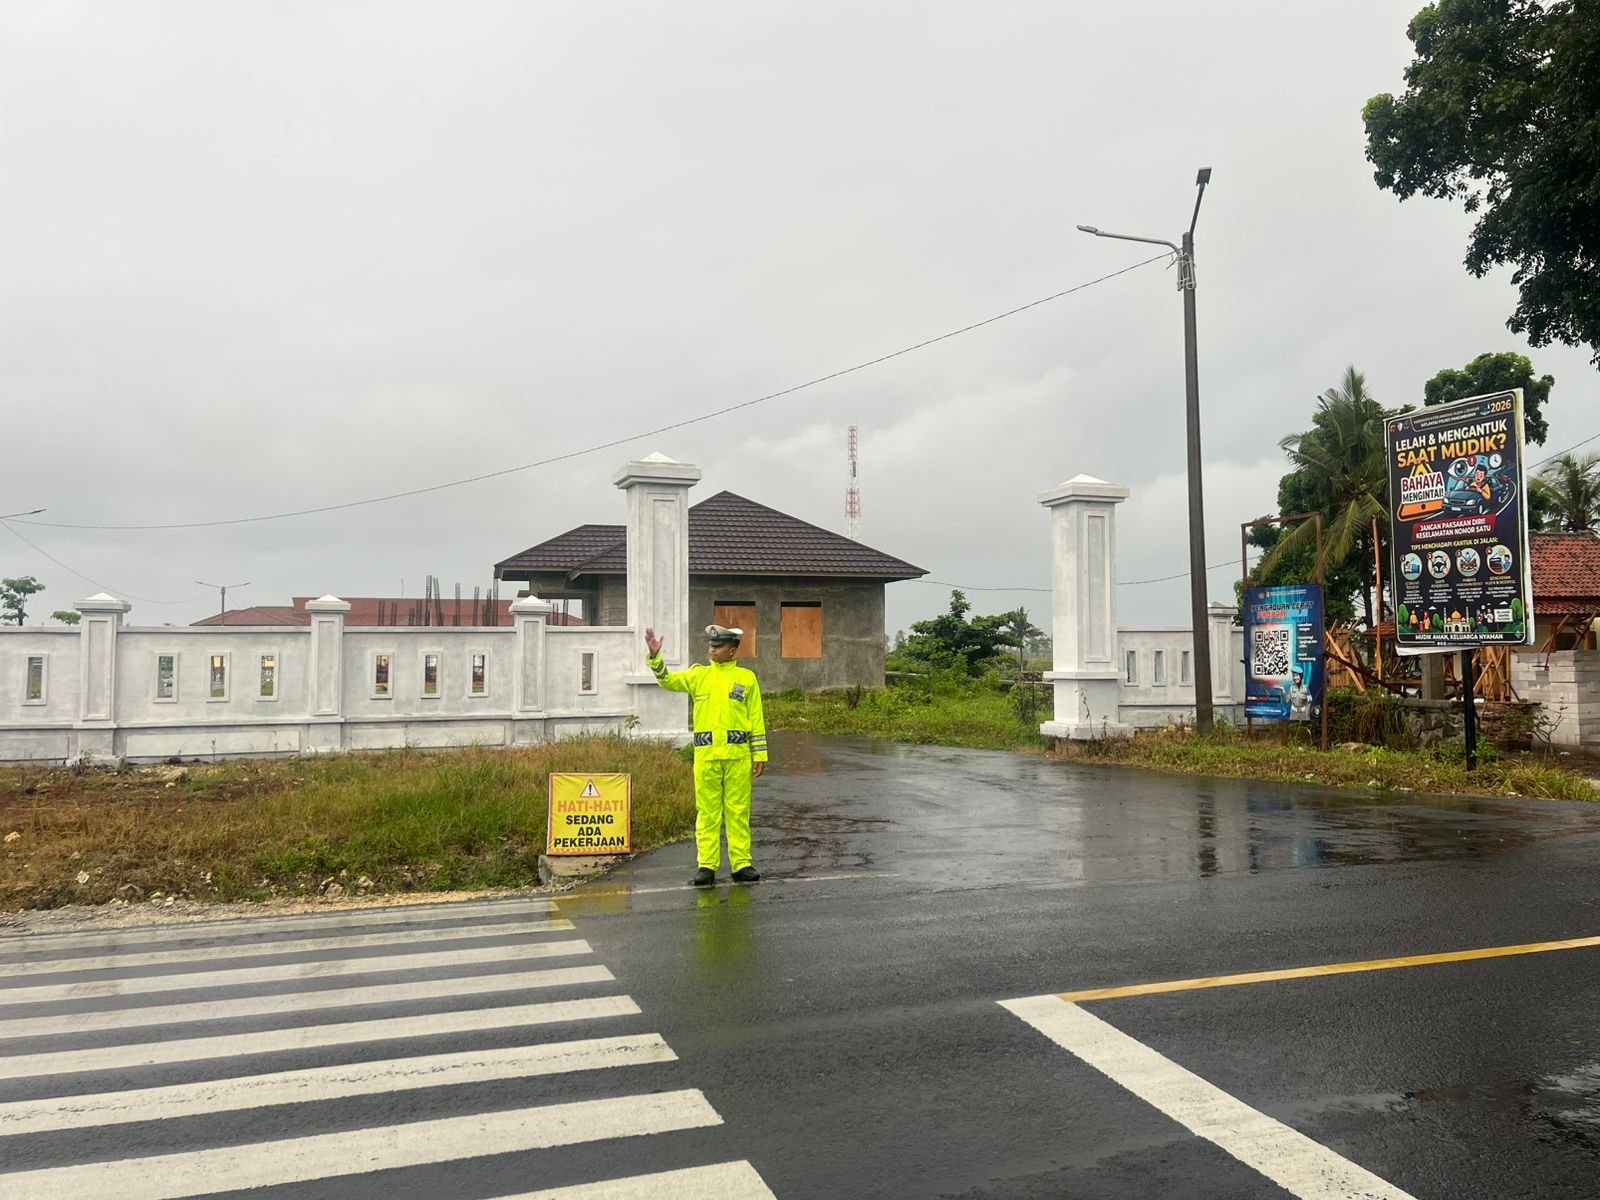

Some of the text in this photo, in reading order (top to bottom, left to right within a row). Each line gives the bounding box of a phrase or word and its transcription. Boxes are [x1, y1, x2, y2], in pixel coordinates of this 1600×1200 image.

[1490, 399, 1511, 413] 2026
[1396, 419, 1508, 452] LELAH & MENGANTUK
[1397, 433, 1507, 468] SAAT MUDIK?
[1402, 473, 1443, 492] BAHAYA
[1402, 489, 1444, 503] MENGINTAI!
[1441, 519, 1471, 529] PAKSAKAN
[1416, 529, 1454, 539] KESELAMATAN
[1454, 527, 1475, 535] NOMOR
[558, 800, 624, 812] HATI-HATI
[566, 814, 614, 825] SEDANG
[577, 826, 602, 837] ADA
[554, 836, 625, 848] PEKERJAAN
